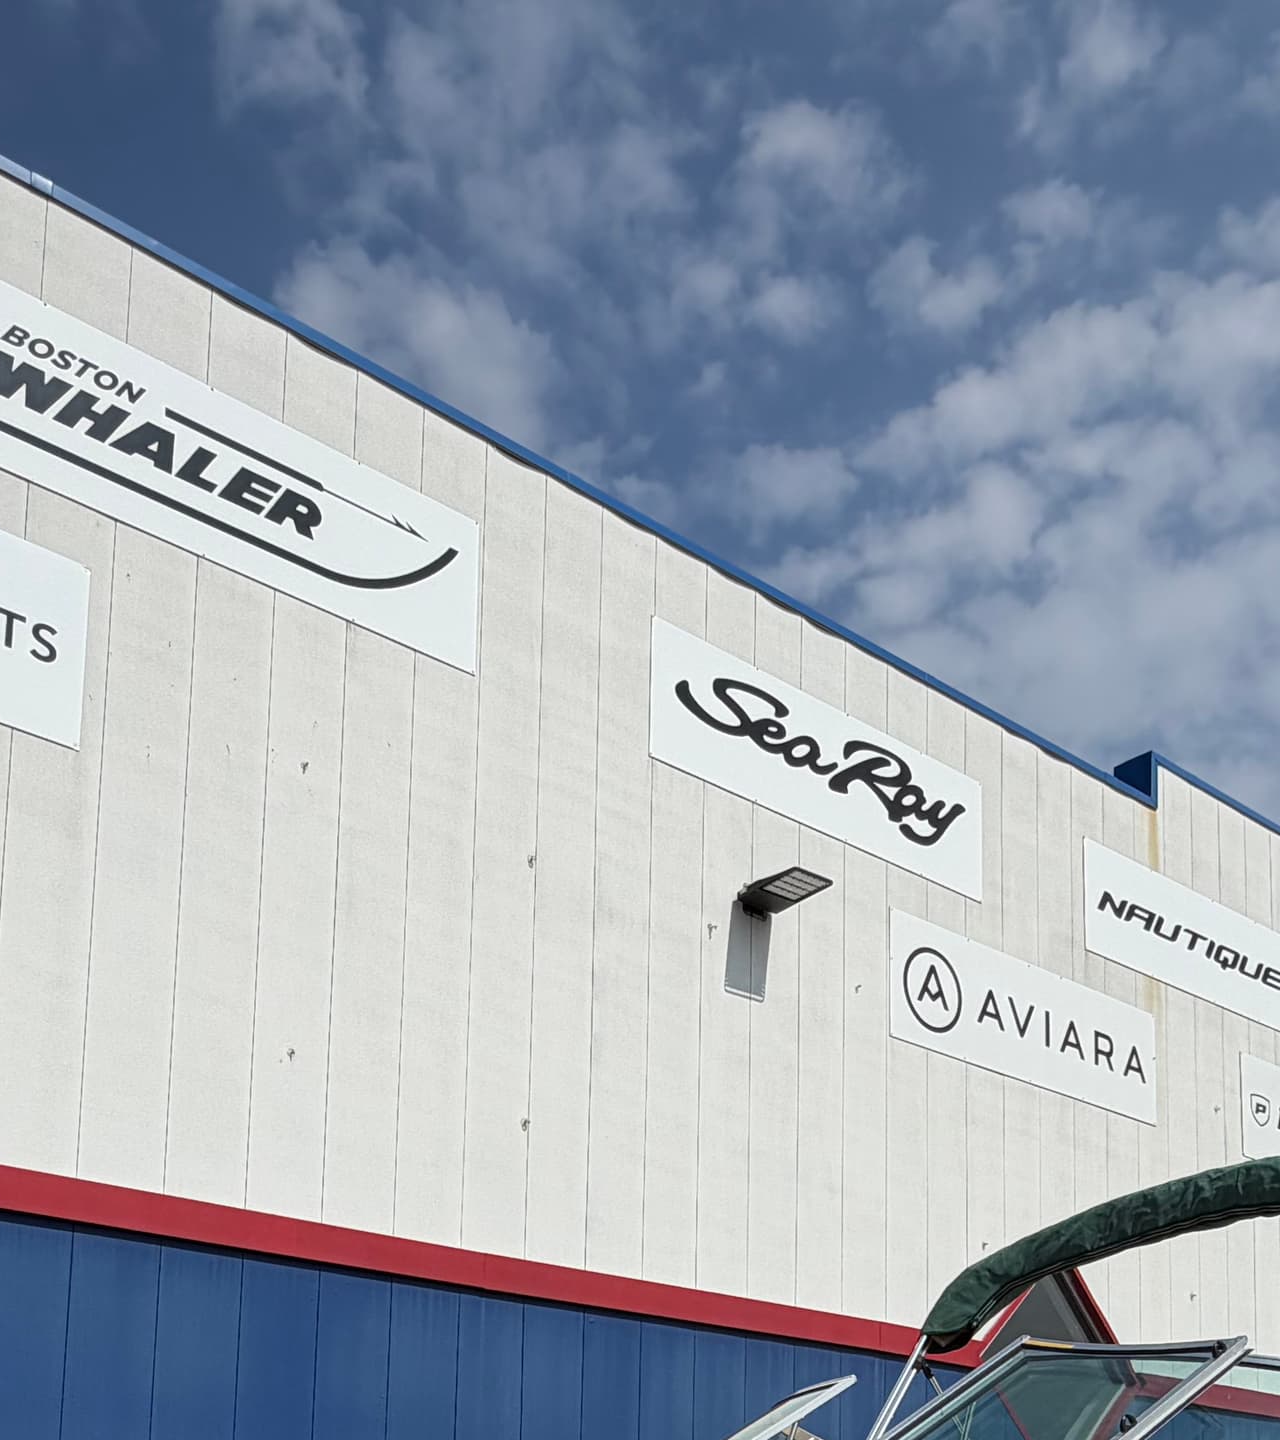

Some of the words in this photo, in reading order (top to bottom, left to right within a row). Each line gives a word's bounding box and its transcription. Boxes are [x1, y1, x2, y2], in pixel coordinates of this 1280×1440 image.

[0, 324, 147, 405] BOSTON
[674, 677, 839, 776] Sea
[827, 739, 967, 847] Ray
[977, 989, 1147, 1085] AVIARA
